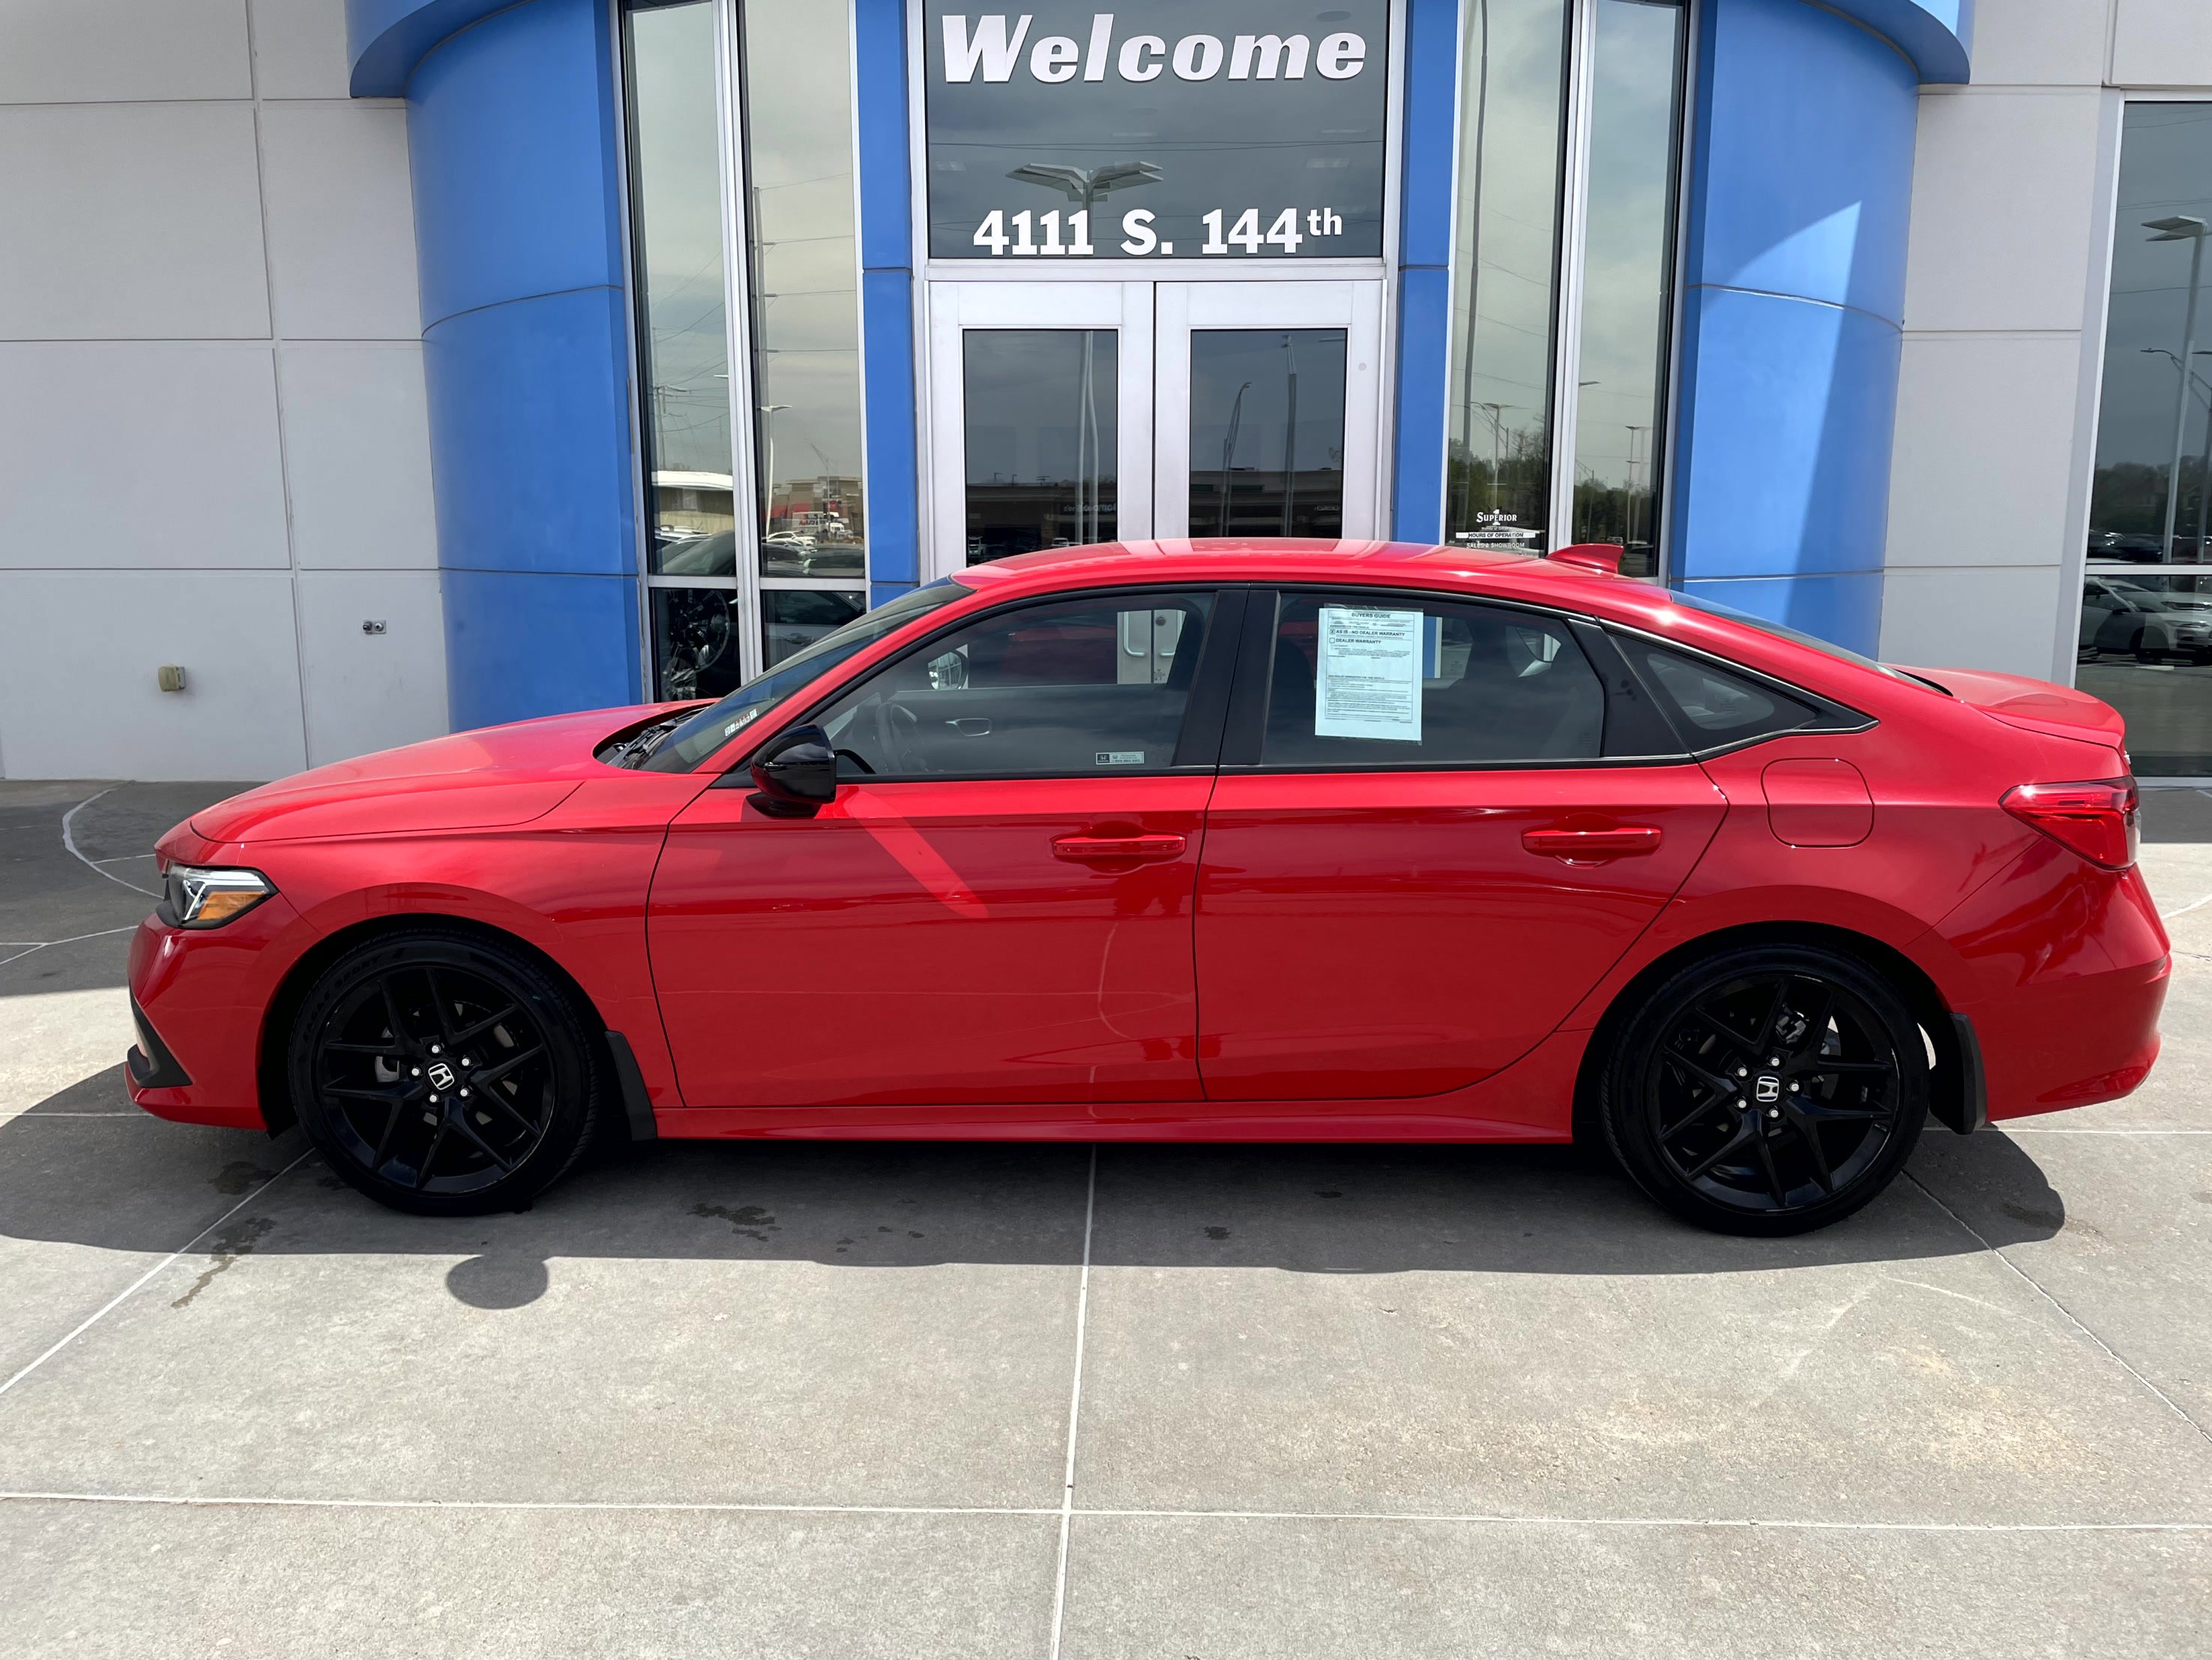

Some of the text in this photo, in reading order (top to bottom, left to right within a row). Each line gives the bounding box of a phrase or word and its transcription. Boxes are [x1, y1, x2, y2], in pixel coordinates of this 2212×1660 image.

[942, 13, 1366, 83] Welcome
[974, 207, 1342, 256] 4111 S. 144th
